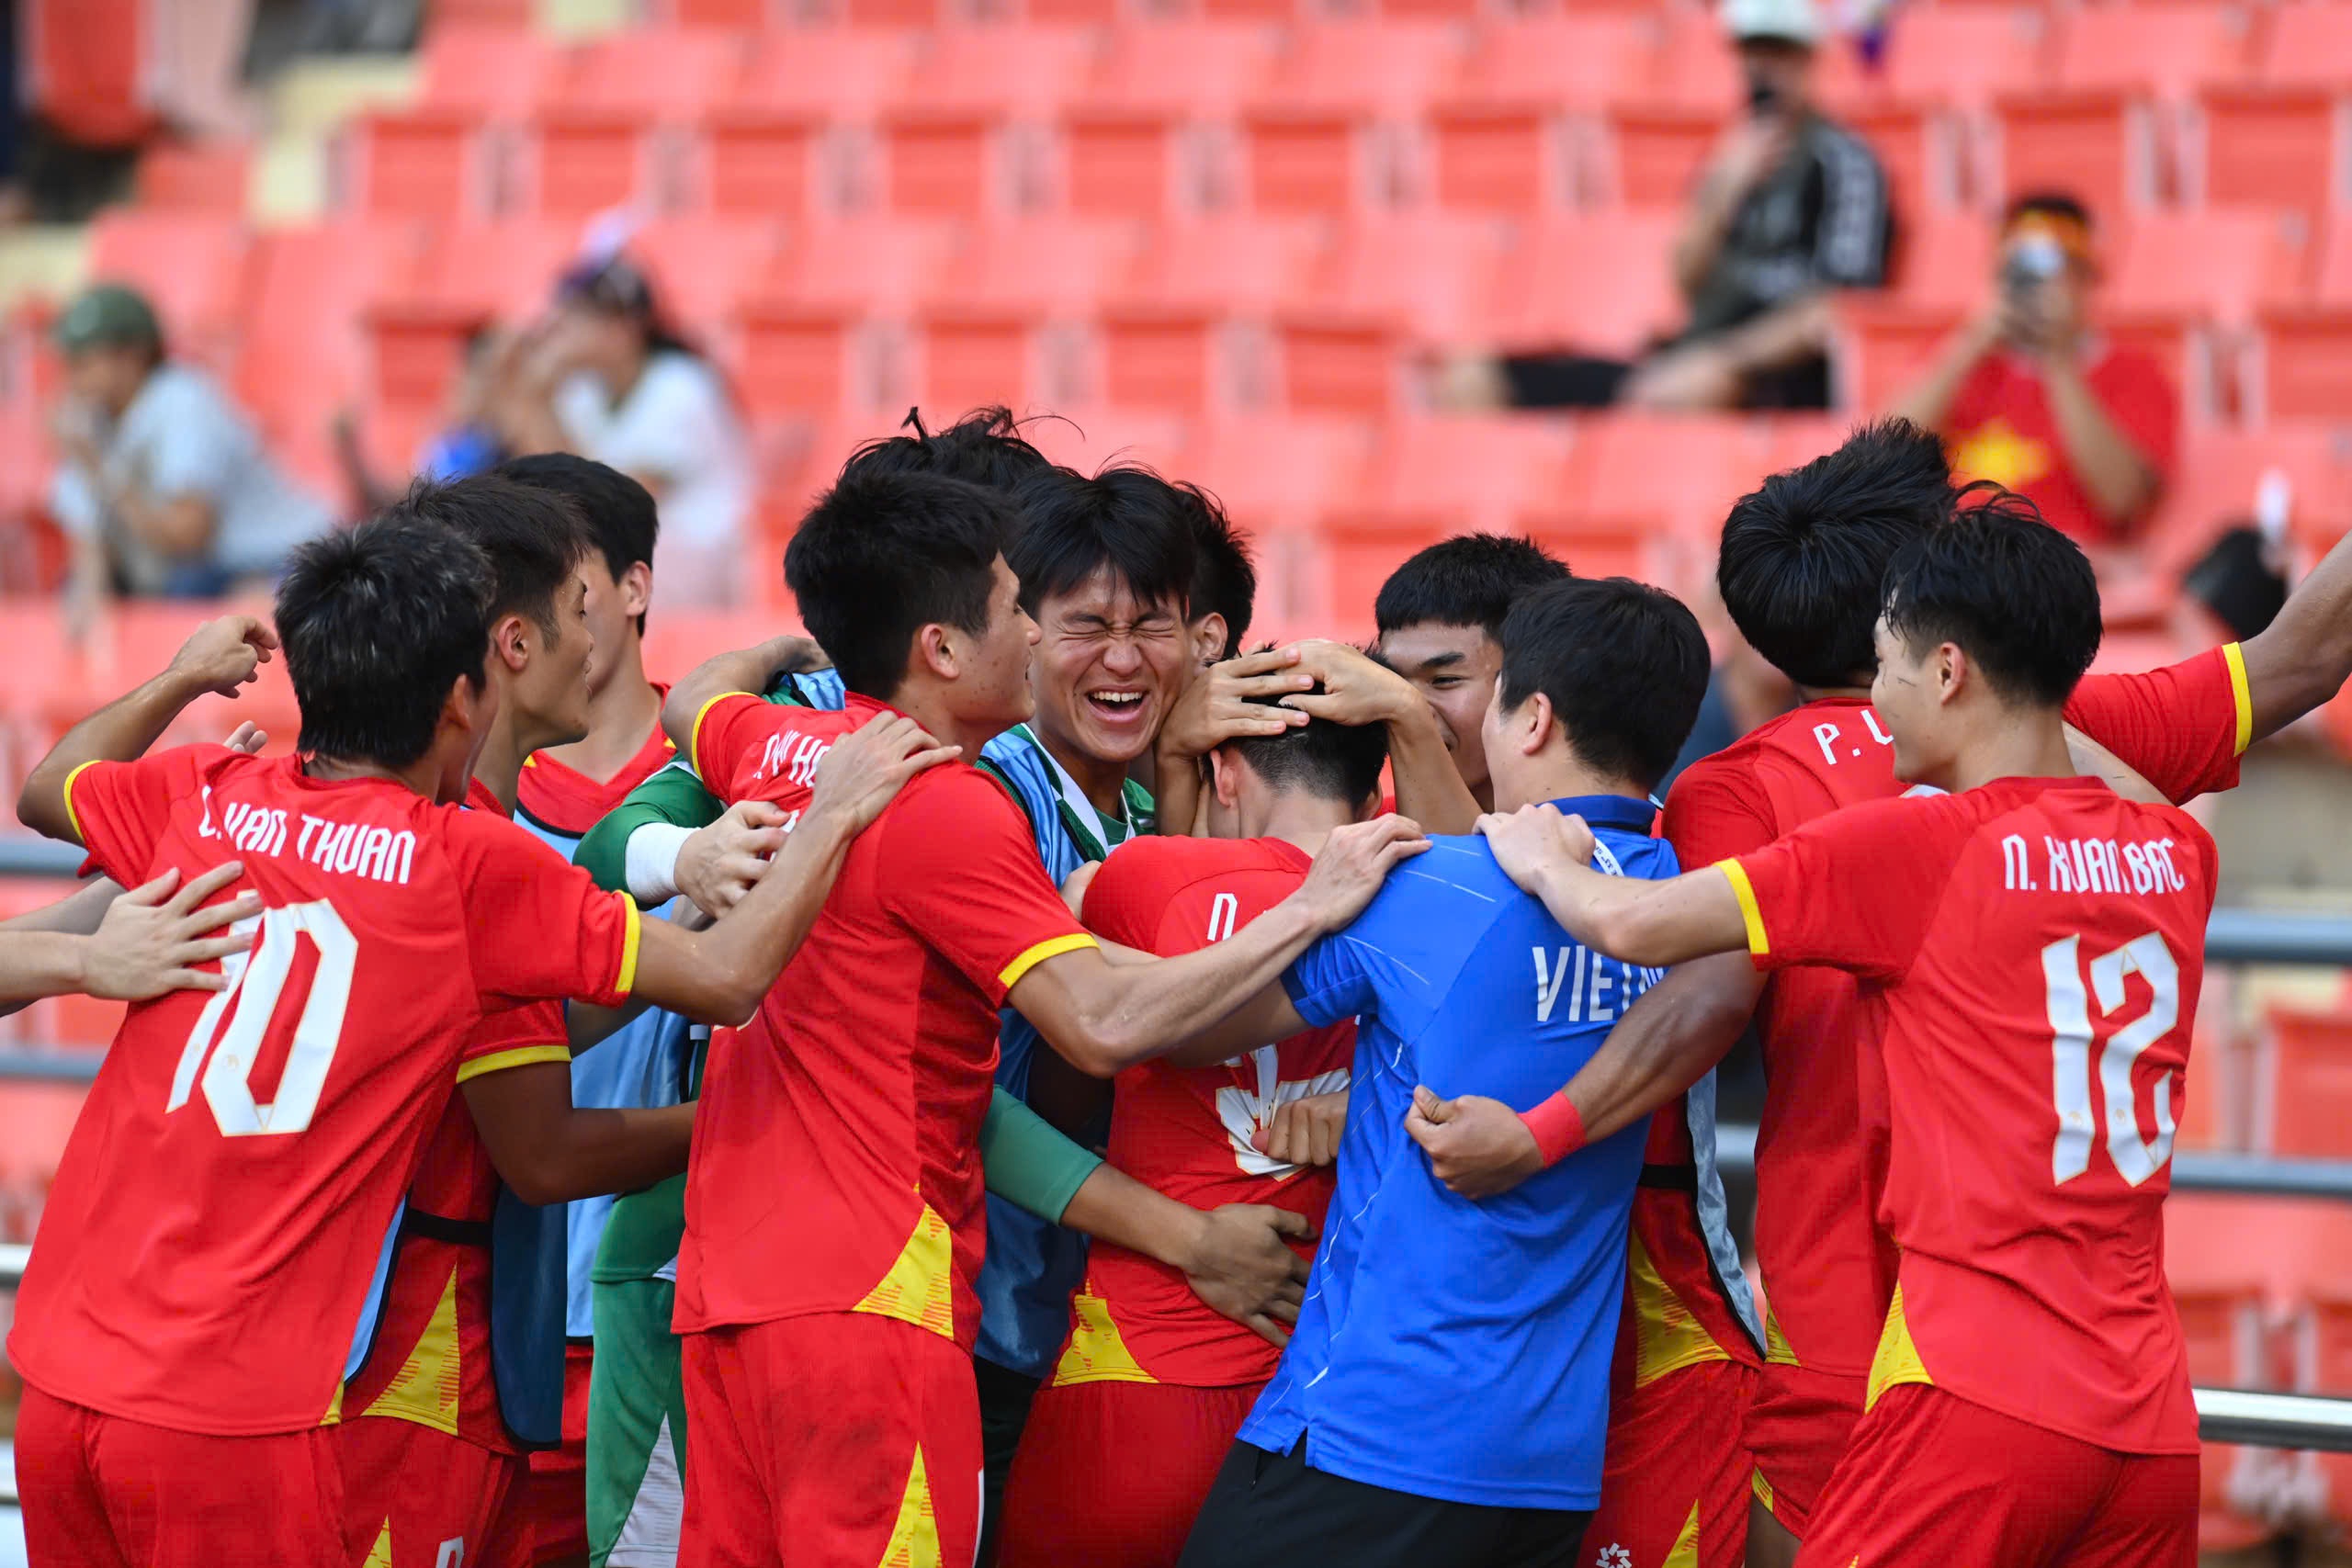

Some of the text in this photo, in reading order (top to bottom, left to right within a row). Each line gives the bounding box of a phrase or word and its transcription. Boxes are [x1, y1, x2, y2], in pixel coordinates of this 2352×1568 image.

[1813, 723, 1860, 765] P.
[297, 814, 416, 885] THUAN
[2002, 834, 2185, 896] N. XUAN BAC
[164, 888, 359, 1137] 10
[2041, 931, 2179, 1188] 12
